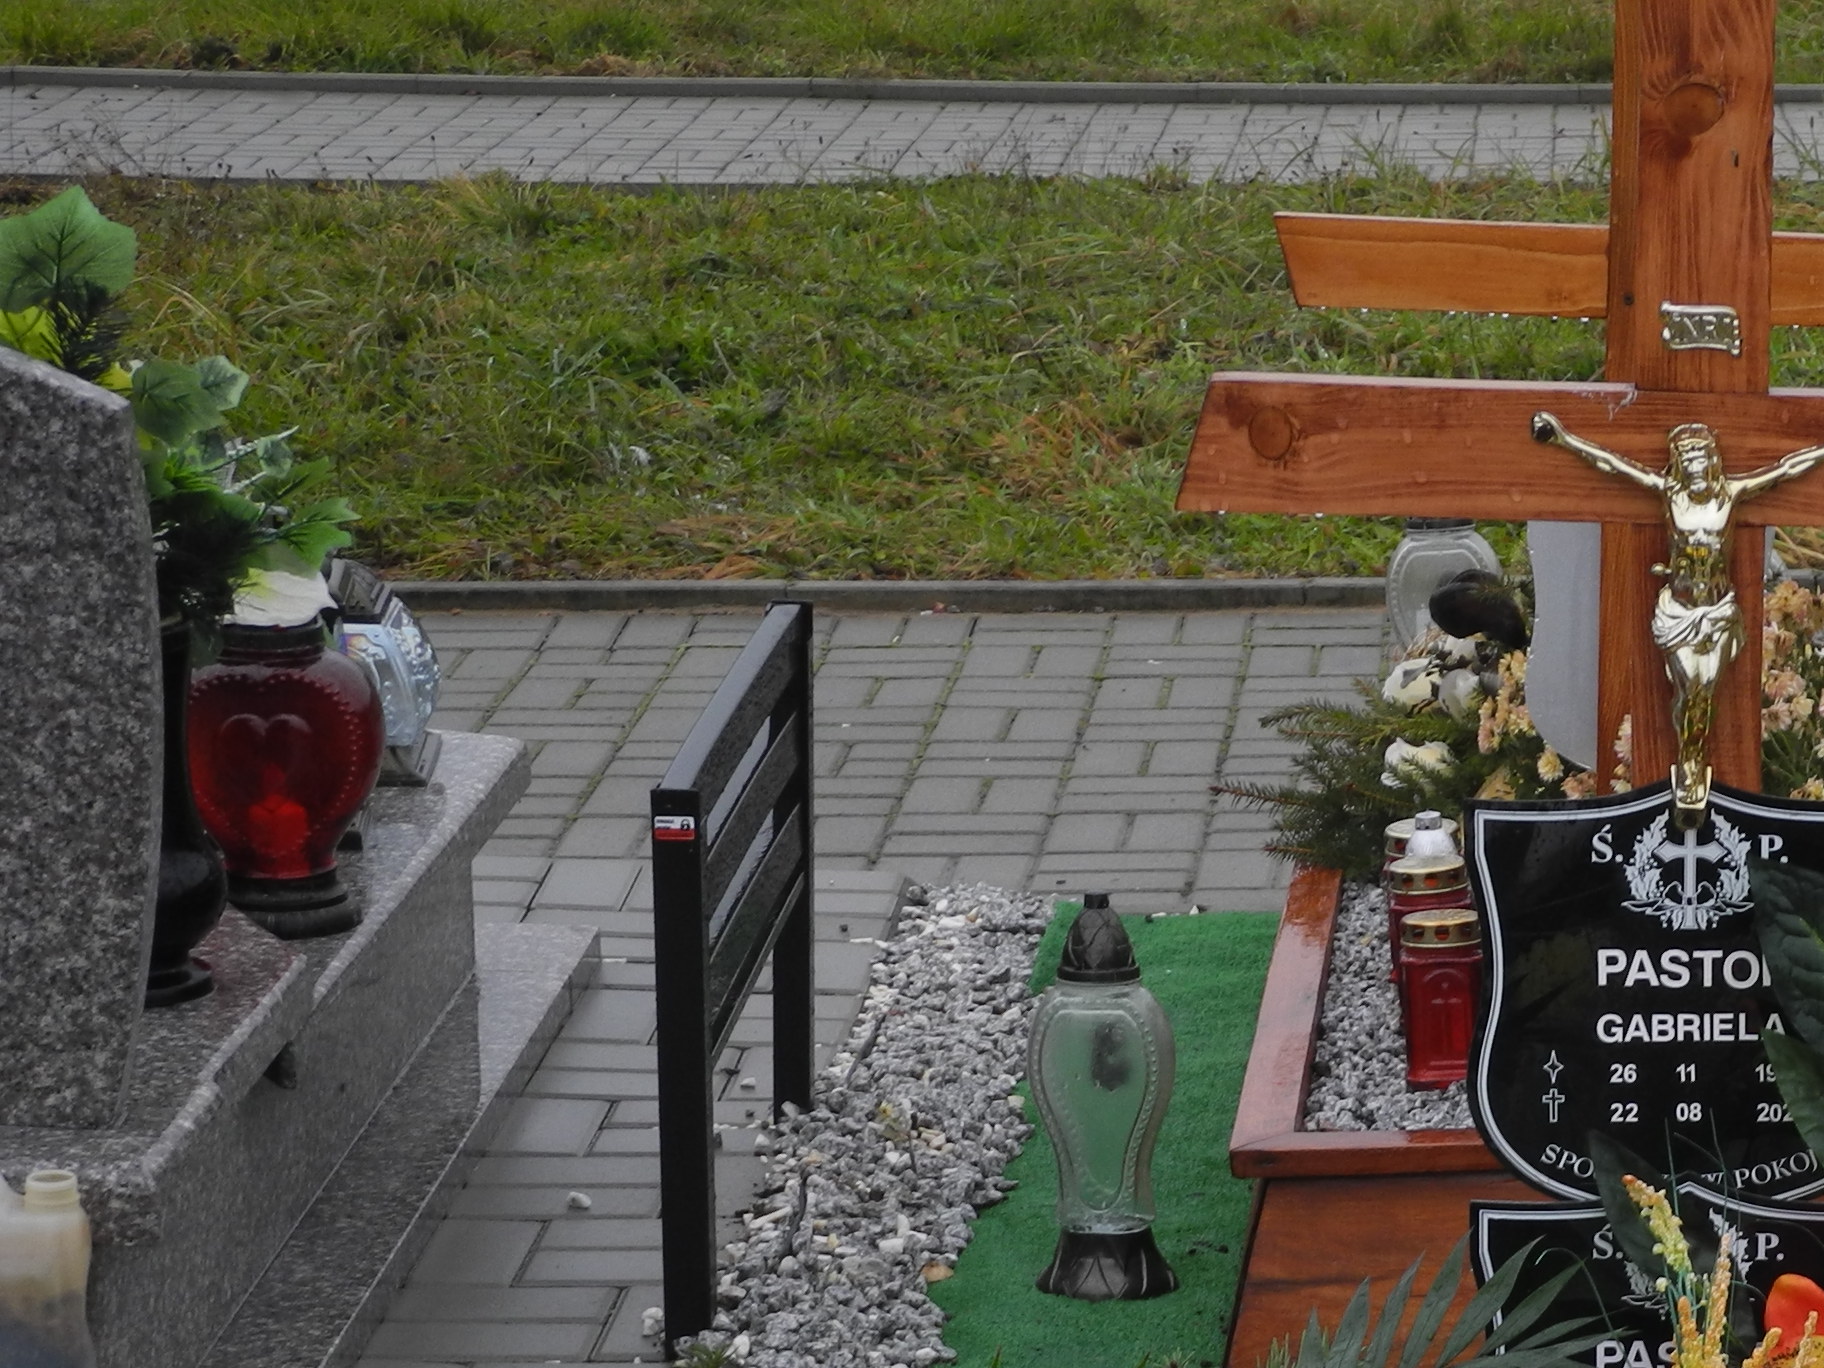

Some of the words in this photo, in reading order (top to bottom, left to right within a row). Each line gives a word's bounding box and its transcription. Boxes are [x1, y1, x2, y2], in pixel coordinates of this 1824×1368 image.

[1591, 825, 1623, 864] Ś.
[1759, 834, 1789, 864] P.
[1596, 1012, 1786, 1043] GABRIELA
[1609, 1063, 1637, 1084] 26
[1675, 1063, 1697, 1084] 11
[1609, 1103, 1639, 1123] 22
[1676, 1102, 1702, 1123] 08
[1592, 1224, 1623, 1260] Ś.
[1755, 1232, 1785, 1261] P.
